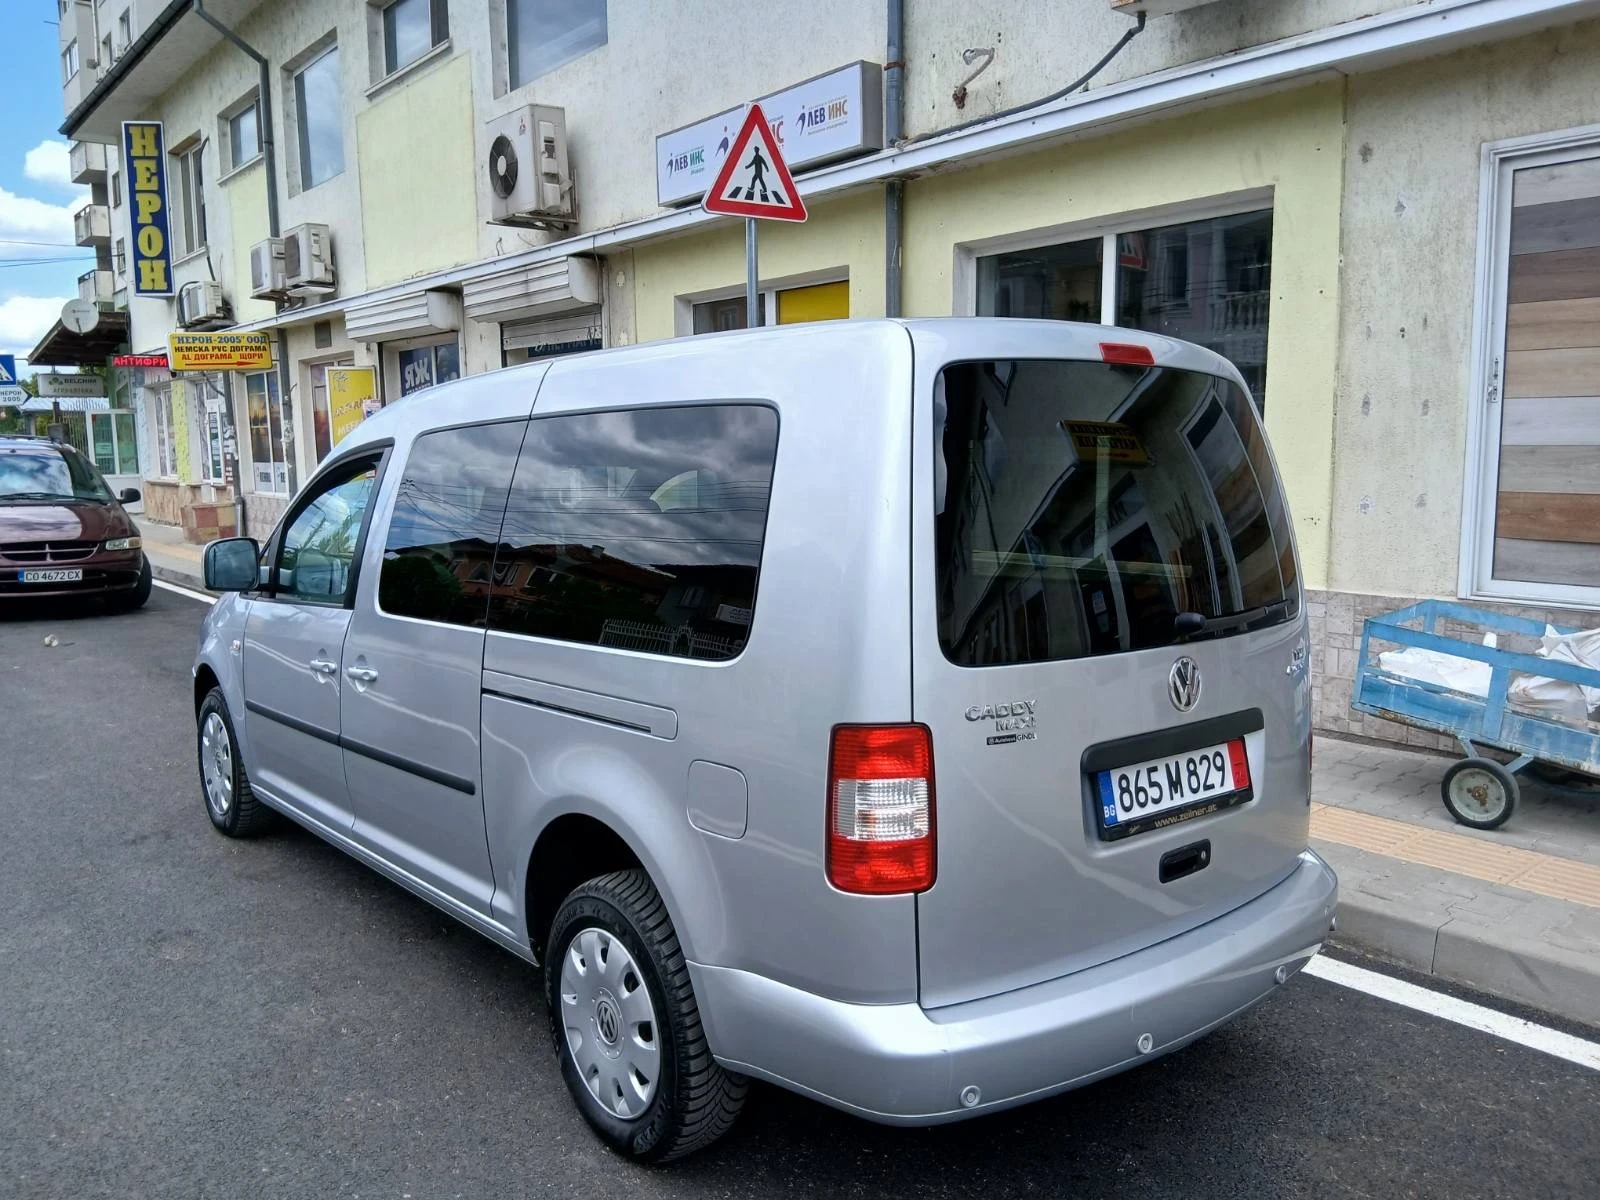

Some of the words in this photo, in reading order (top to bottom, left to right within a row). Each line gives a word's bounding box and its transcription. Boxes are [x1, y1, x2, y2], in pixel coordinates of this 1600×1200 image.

[807, 107, 826, 127] ЛЕВ
[828, 100, 848, 120] ИНС
[674, 155, 688, 172] ЛЕВ
[689, 149, 705, 166] ИНС
[129, 126, 168, 290] НЕРОН
[246, 335, 267, 344] ООД
[229, 345, 267, 353] ДОГРАМА
[239, 352, 264, 360] ЩОРИ
[41, 571, 66, 580] 4672
[67, 570, 81, 580] CX
[964, 700, 1038, 722] CADDY
[995, 716, 1036, 732] MAXI
[1117, 765, 1163, 813] 865
[1165, 760, 1185, 801] M
[1186, 750, 1226, 794] 829
[1103, 804, 1116, 818] BG
